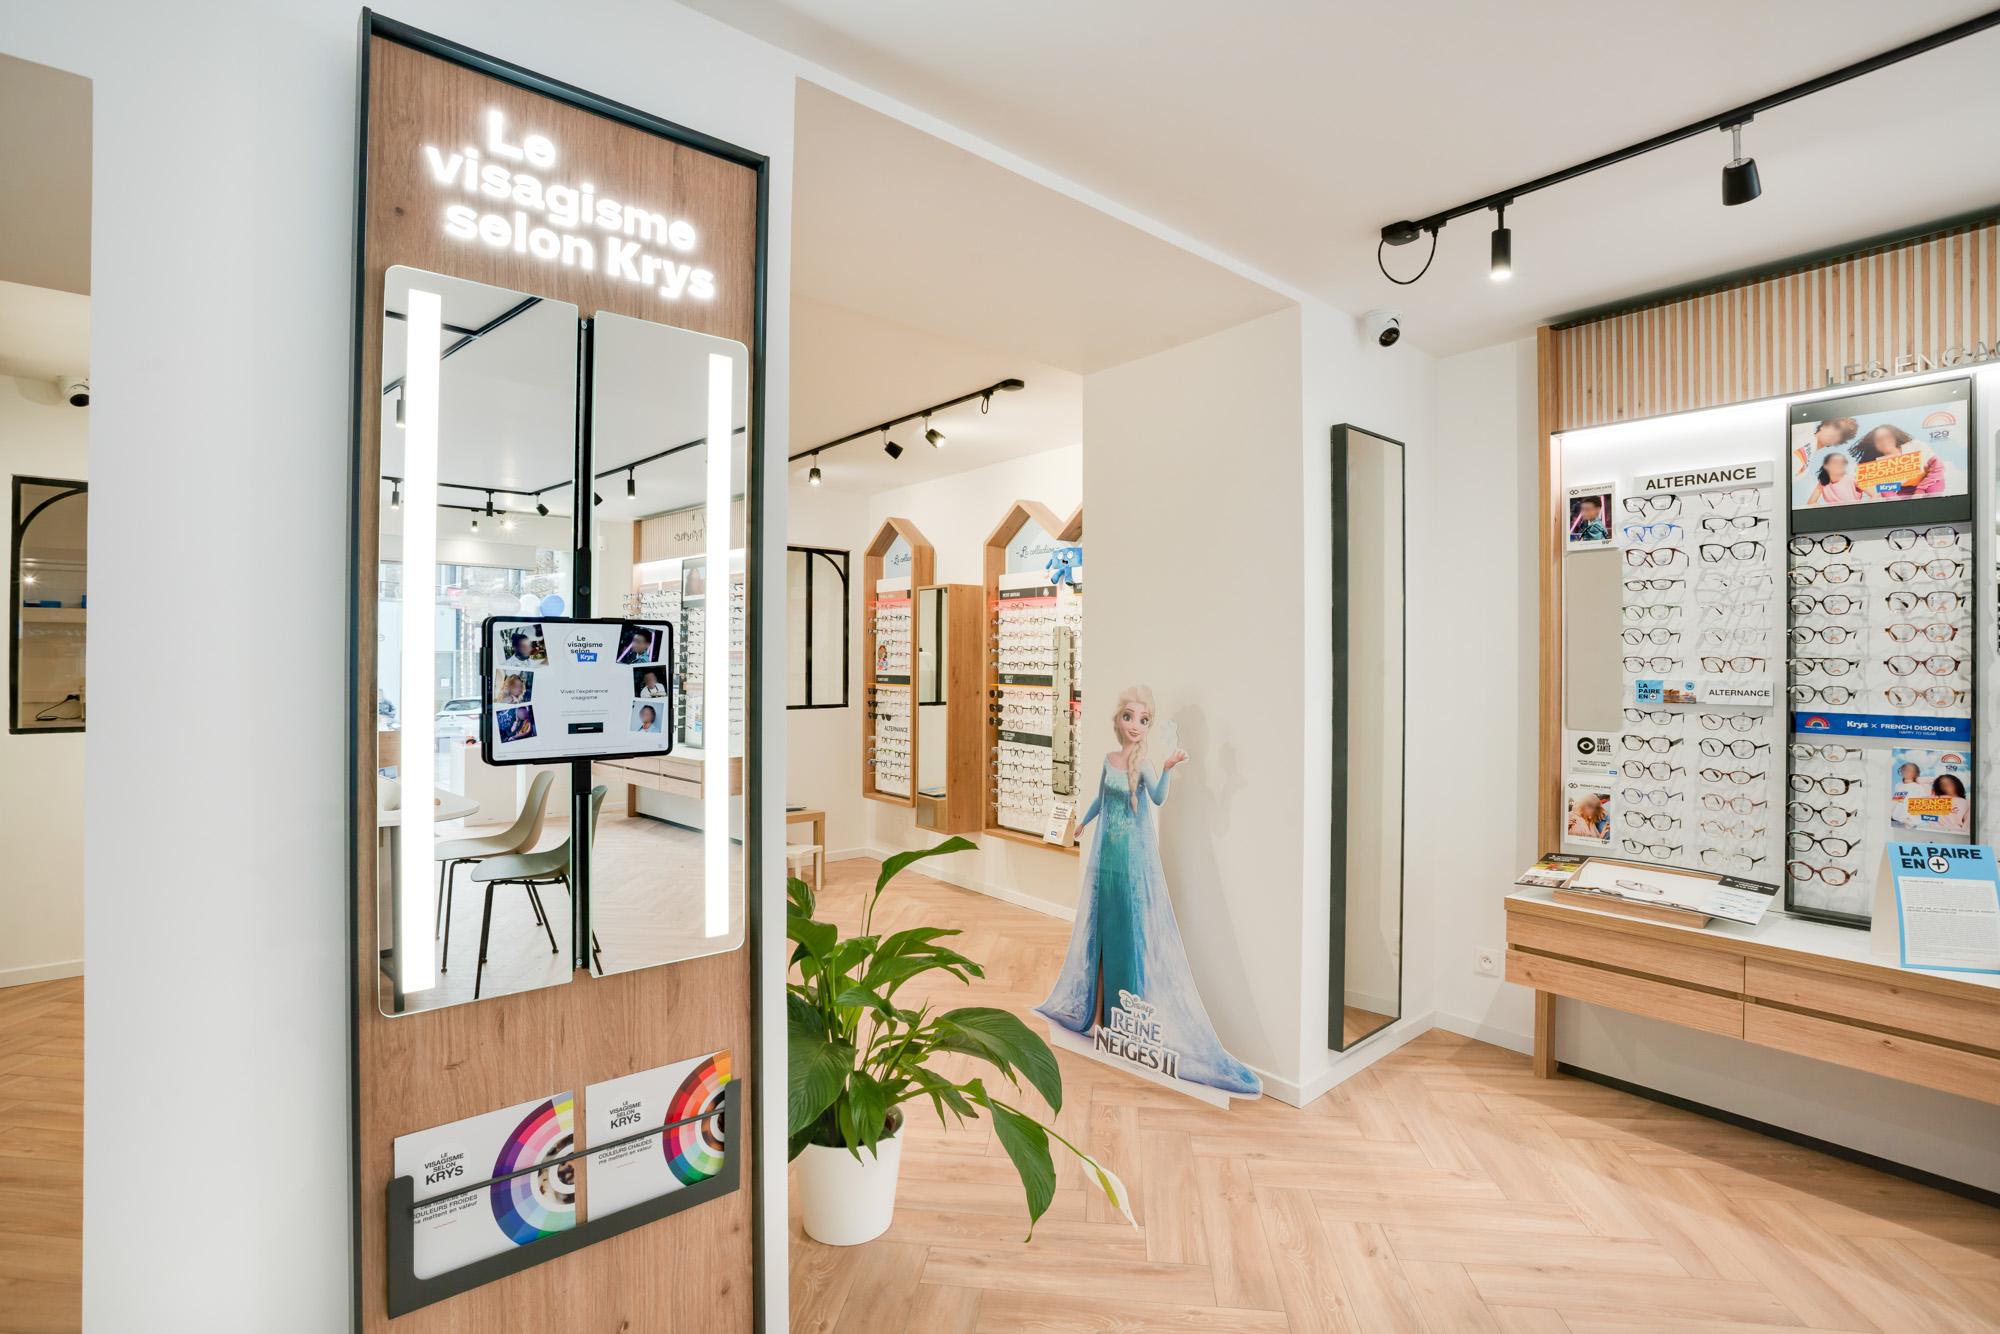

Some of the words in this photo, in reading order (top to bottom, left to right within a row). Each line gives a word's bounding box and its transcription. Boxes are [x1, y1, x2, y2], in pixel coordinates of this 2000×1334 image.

[487, 109, 556, 167] Le
[607, 236, 716, 299] Krys
[1894, 340, 2000, 376] ENGA
[1857, 451, 1921, 473] FRENCH
[1645, 466, 1757, 491] ALTERNANCE
[1857, 462, 1921, 482] DISORDER
[568, 641, 603, 649] visagisme
[580, 653, 594, 661] Krys
[1708, 689, 1770, 697] ALTERNANCE
[884, 725, 908, 733] ALTERNANCE
[1847, 720, 1869, 729] Krys
[1881, 723, 1913, 731] FRENCH
[1914, 724, 1956, 732] DISORDER
[1899, 846, 1923, 857] LA
[1927, 847, 1983, 860] PAIRE
[1902, 858, 1926, 870] EN
[1113, 1008, 1162, 1043] REINE
[1095, 1028, 1159, 1070] NEIGES
[1161, 1049, 1177, 1079] II
[609, 1101, 641, 1115] VISAGISME
[617, 1109, 635, 1118] SELON
[610, 1112, 641, 1129] KRYS
[598, 1147, 627, 1160] COULEURS
[628, 1138, 653, 1150] CHAUDES
[424, 1152, 464, 1169] VISAGISME
[433, 1162, 456, 1173] SELON
[425, 1165, 464, 1186] KRYS
[449, 1194, 478, 1207] FROIDES
[423, 1211, 448, 1222] mettent
[459, 1201, 478, 1210] valeur
